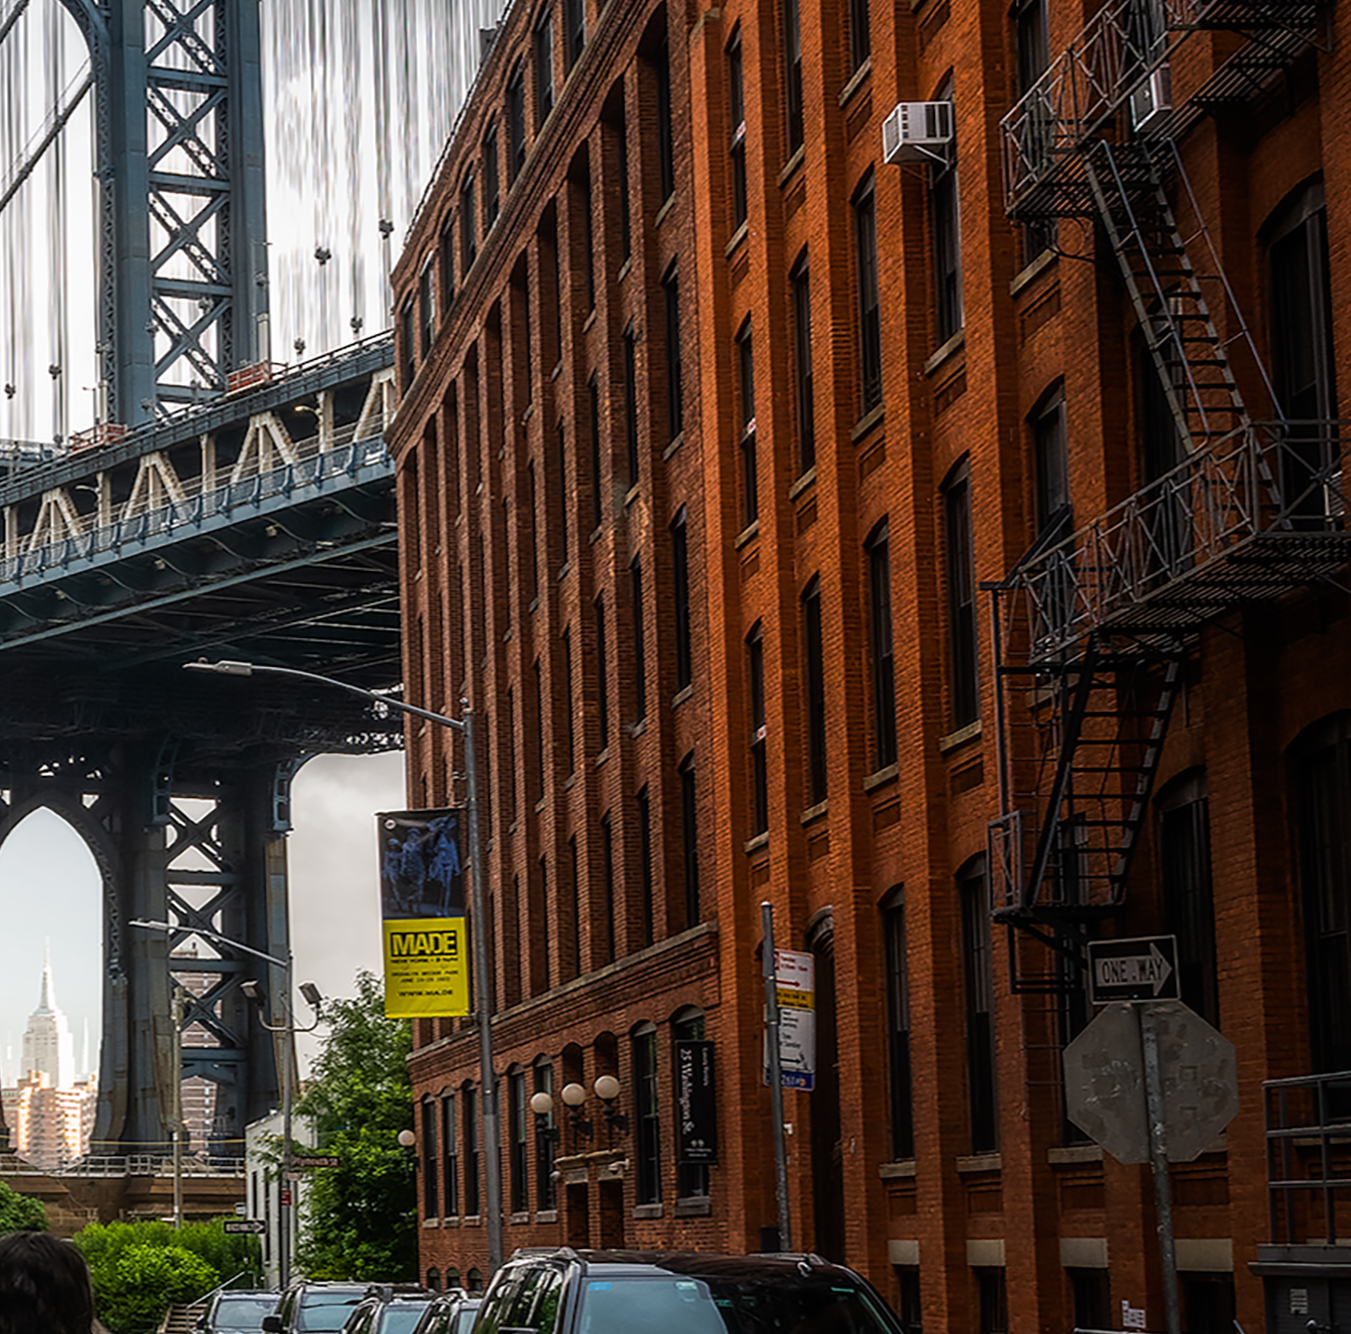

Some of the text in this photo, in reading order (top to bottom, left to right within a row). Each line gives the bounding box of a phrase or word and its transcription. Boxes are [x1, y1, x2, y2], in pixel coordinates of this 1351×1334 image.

[392, 932, 456, 955] MADE
[1102, 957, 1163, 983] ONE WAY
